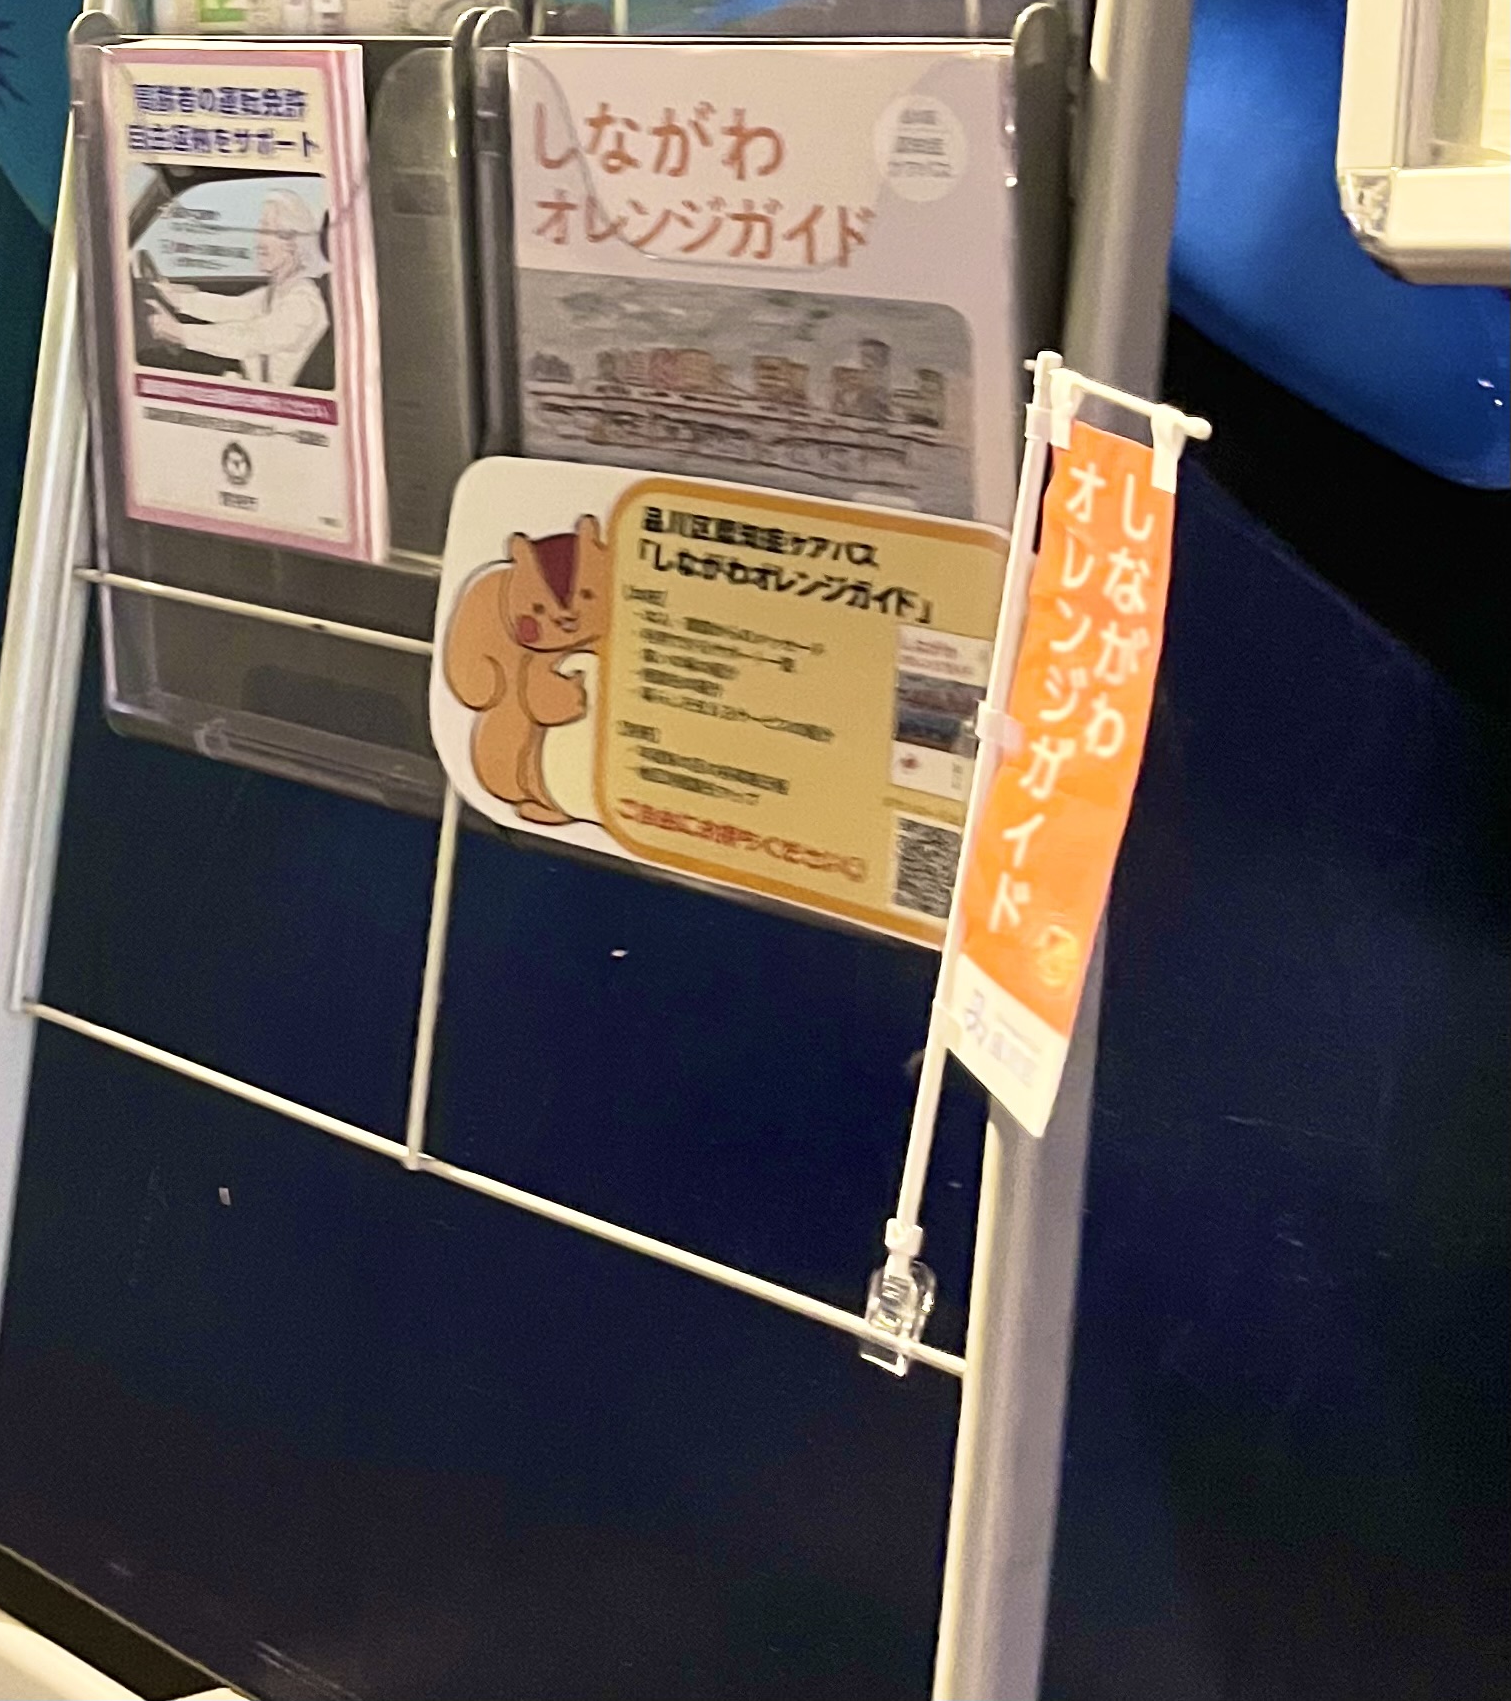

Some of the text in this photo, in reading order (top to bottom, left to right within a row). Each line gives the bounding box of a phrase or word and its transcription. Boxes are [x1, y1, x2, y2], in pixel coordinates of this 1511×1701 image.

[534, 101, 786, 181] しながわ
[534, 189, 877, 267] オレンジガイド
[988, 461, 1106, 934] オレンジガイド
[1084, 471, 1156, 760] しながわ
